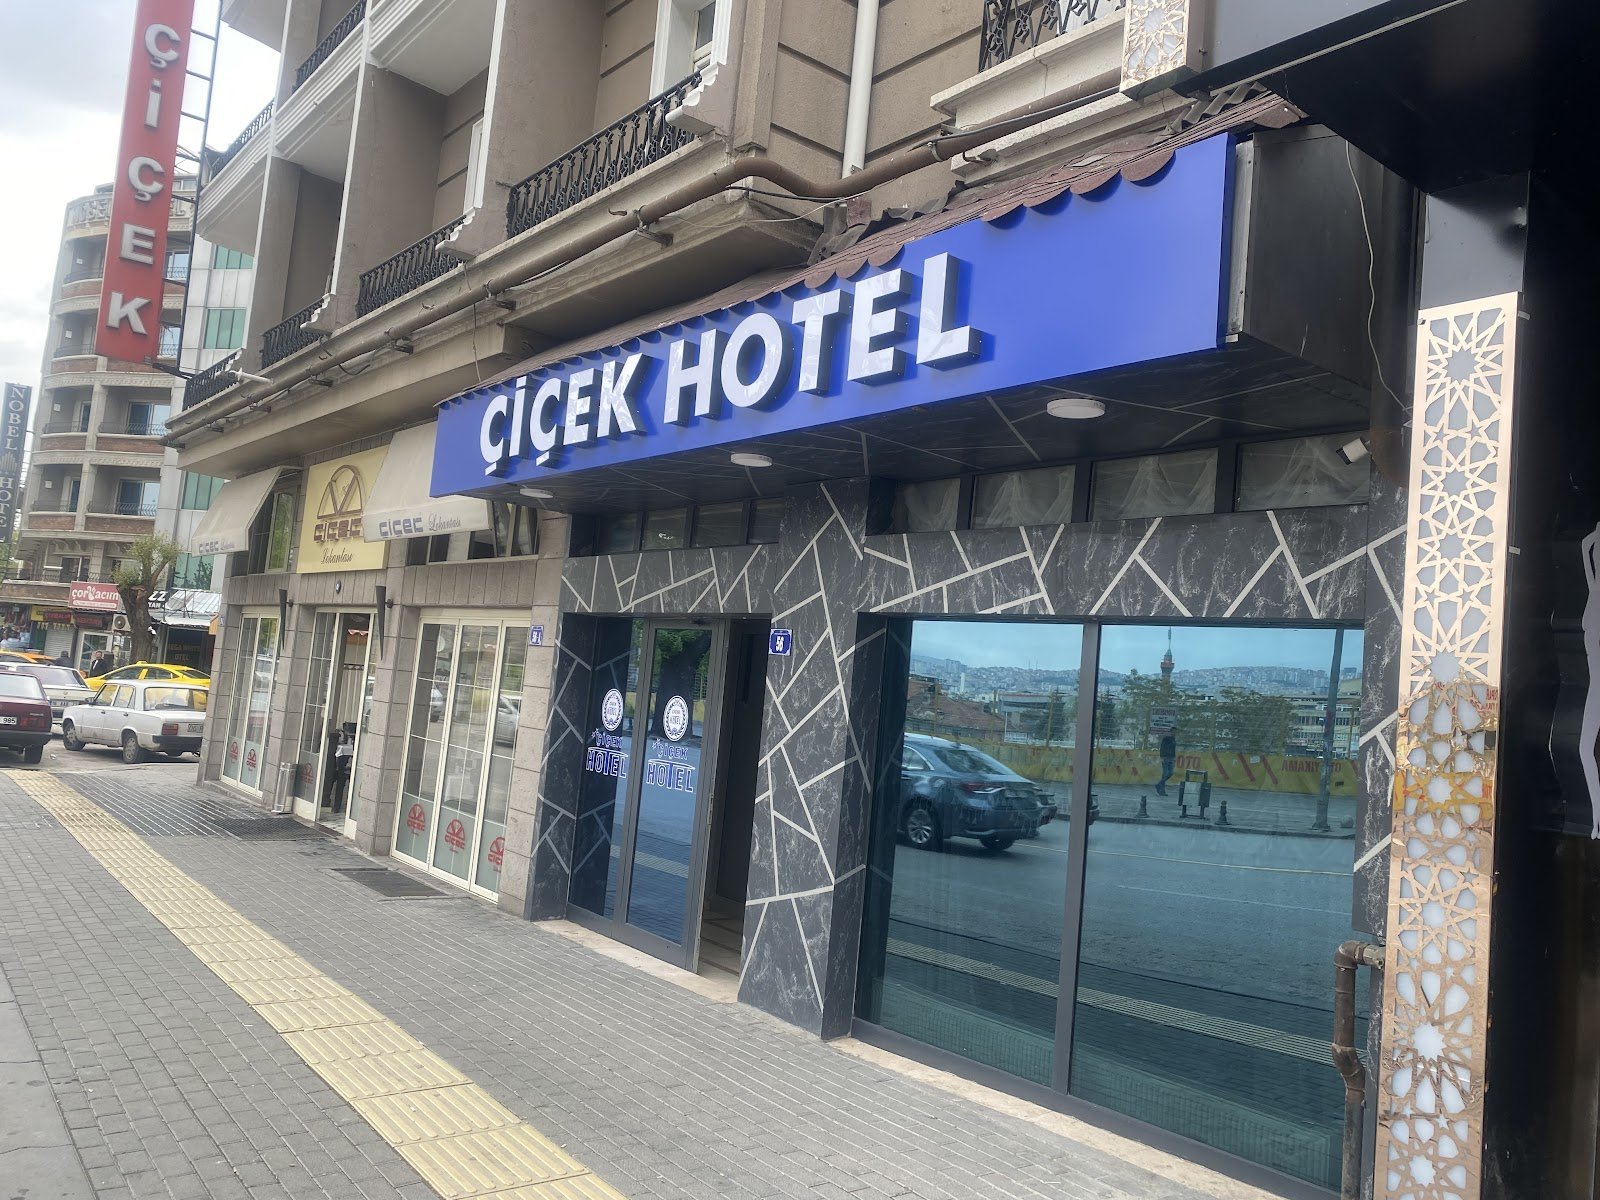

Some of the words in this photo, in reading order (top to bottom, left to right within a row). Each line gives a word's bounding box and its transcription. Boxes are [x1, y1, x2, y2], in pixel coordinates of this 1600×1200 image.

[106, 23, 181, 336] ÇİÇEK
[479, 352, 645, 477] ÇİÇEK
[663, 251, 975, 425] HOTEL
[6, 387, 24, 450] NOBEL
[775, 635, 785, 652] 56
[586, 747, 629, 778] HOTEL
[646, 759, 696, 793] HOTEL
